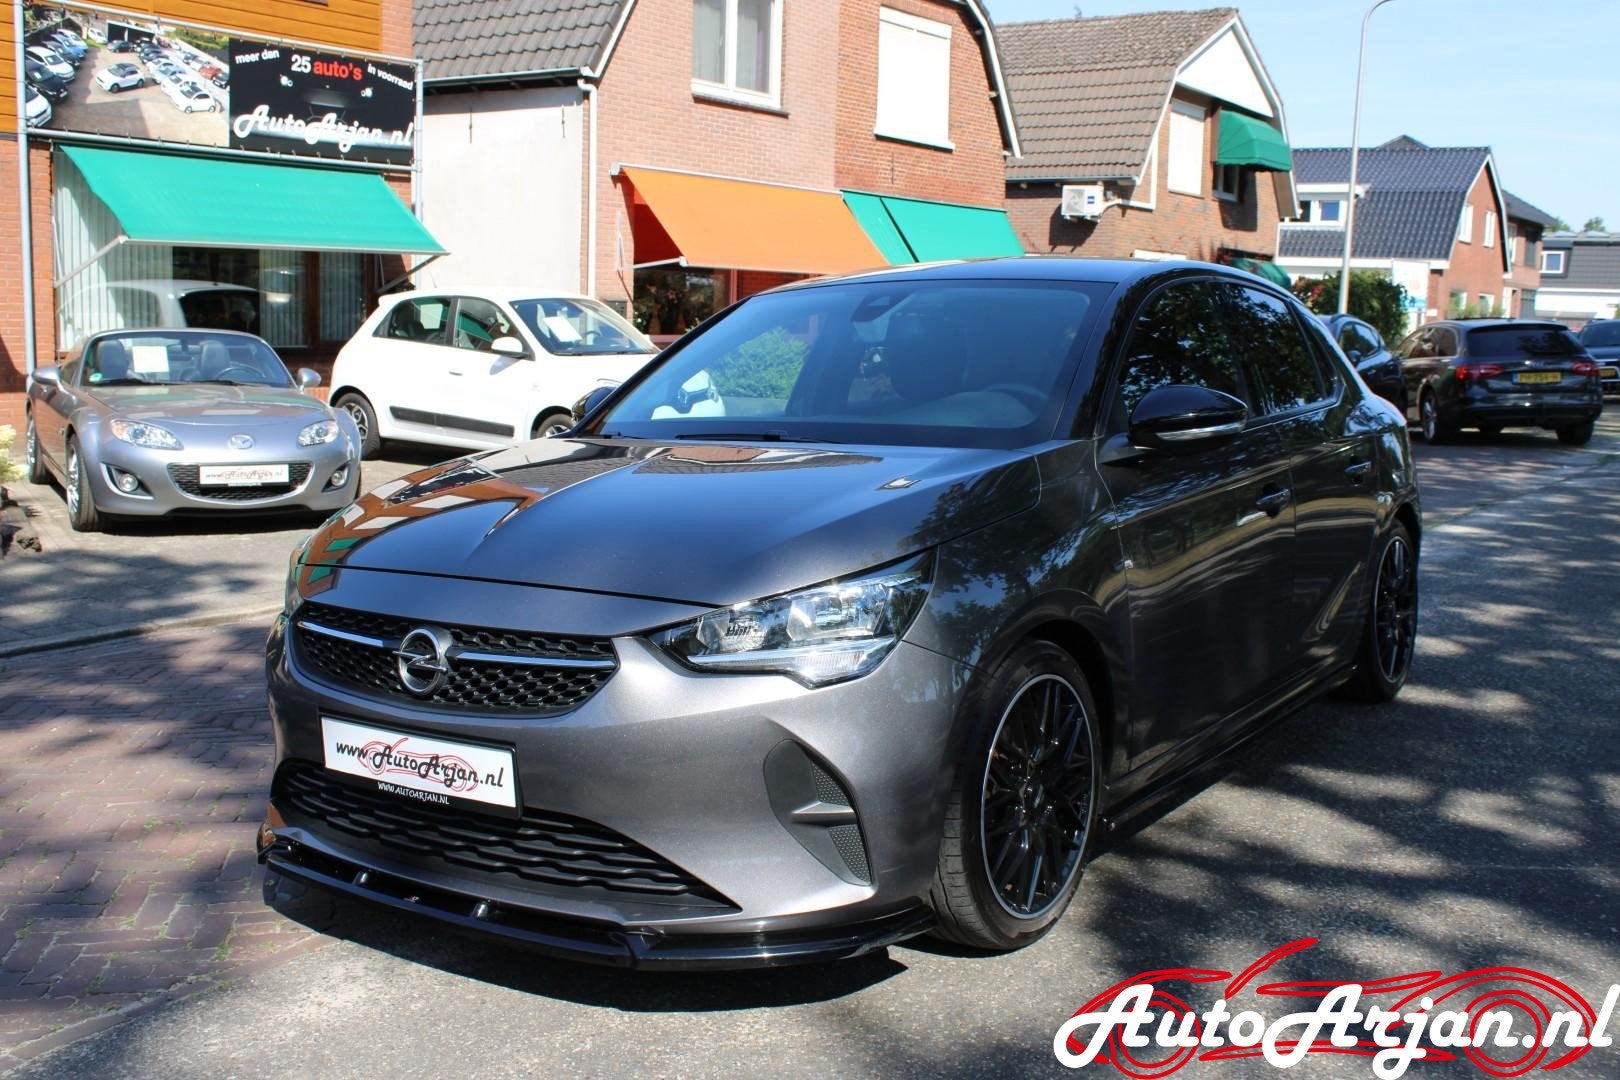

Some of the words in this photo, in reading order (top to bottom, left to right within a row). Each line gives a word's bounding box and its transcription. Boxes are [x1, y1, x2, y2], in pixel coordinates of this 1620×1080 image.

[235, 52, 260, 65] meer
[262, 49, 280, 61] dan
[291, 54, 312, 74] 25
[313, 60, 363, 81] auto's
[367, 63, 377, 75] in
[377, 68, 413, 91] voorraad
[233, 104, 414, 153] AutoArjan.nl
[336, 742, 504, 788] www.AutoArjan.nl
[378, 781, 450, 805] WWW.AUTOARJAN.NL
